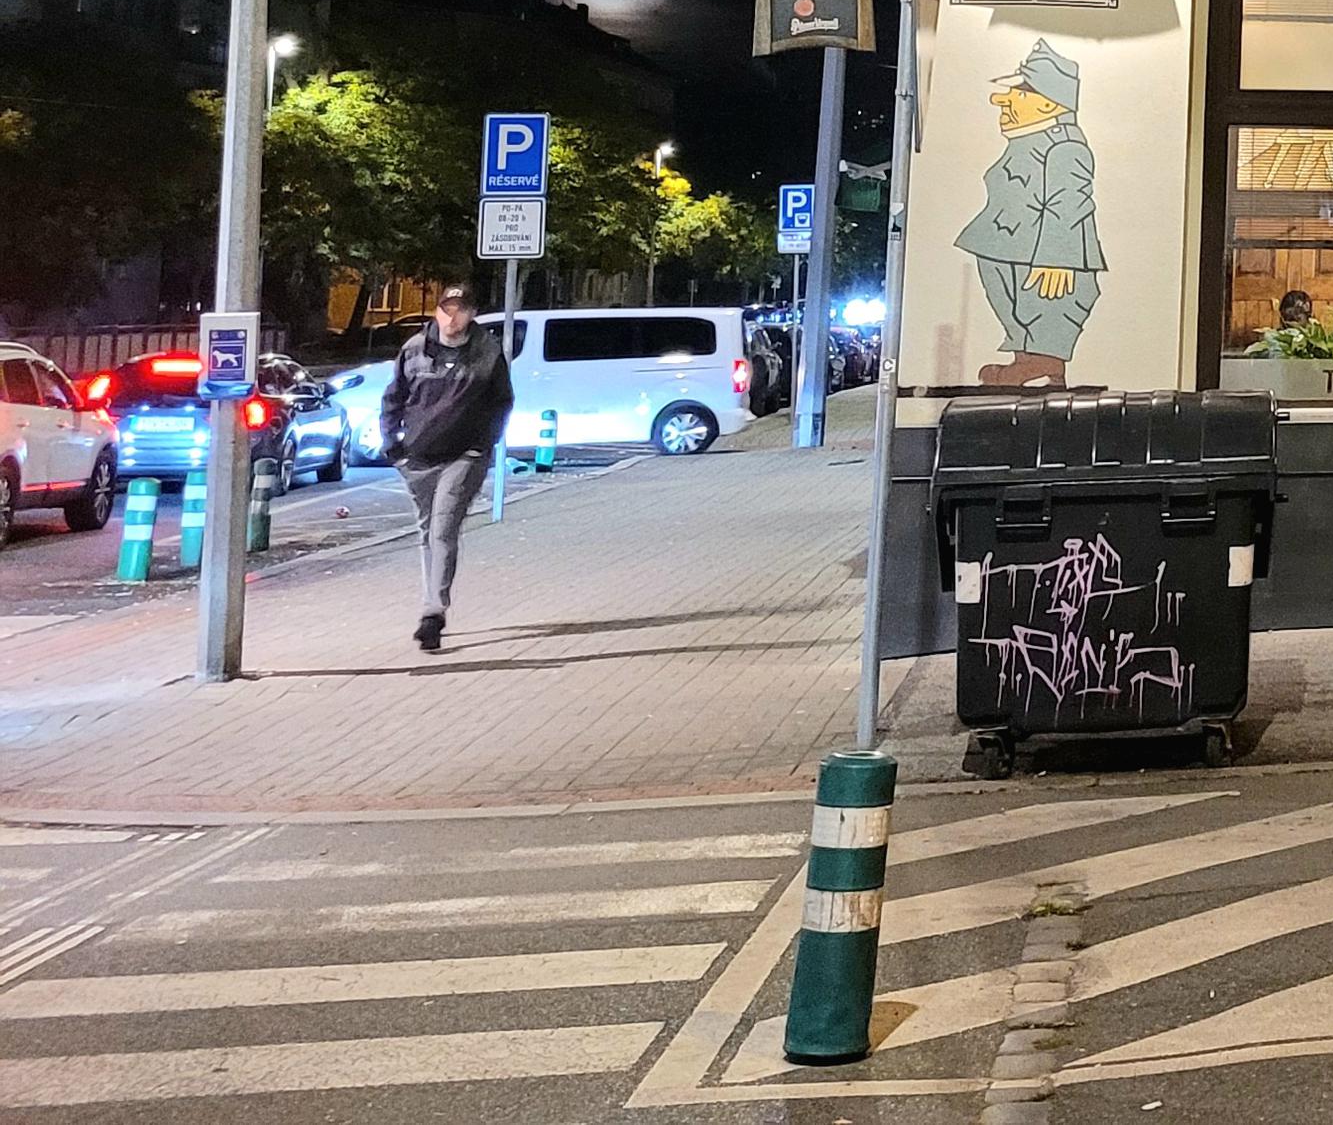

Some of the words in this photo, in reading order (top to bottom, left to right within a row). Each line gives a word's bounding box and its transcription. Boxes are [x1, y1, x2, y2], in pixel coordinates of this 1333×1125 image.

[497, 124, 534, 170] P
[488, 174, 540, 187] RÉSERVÉ
[787, 191, 808, 218] P
